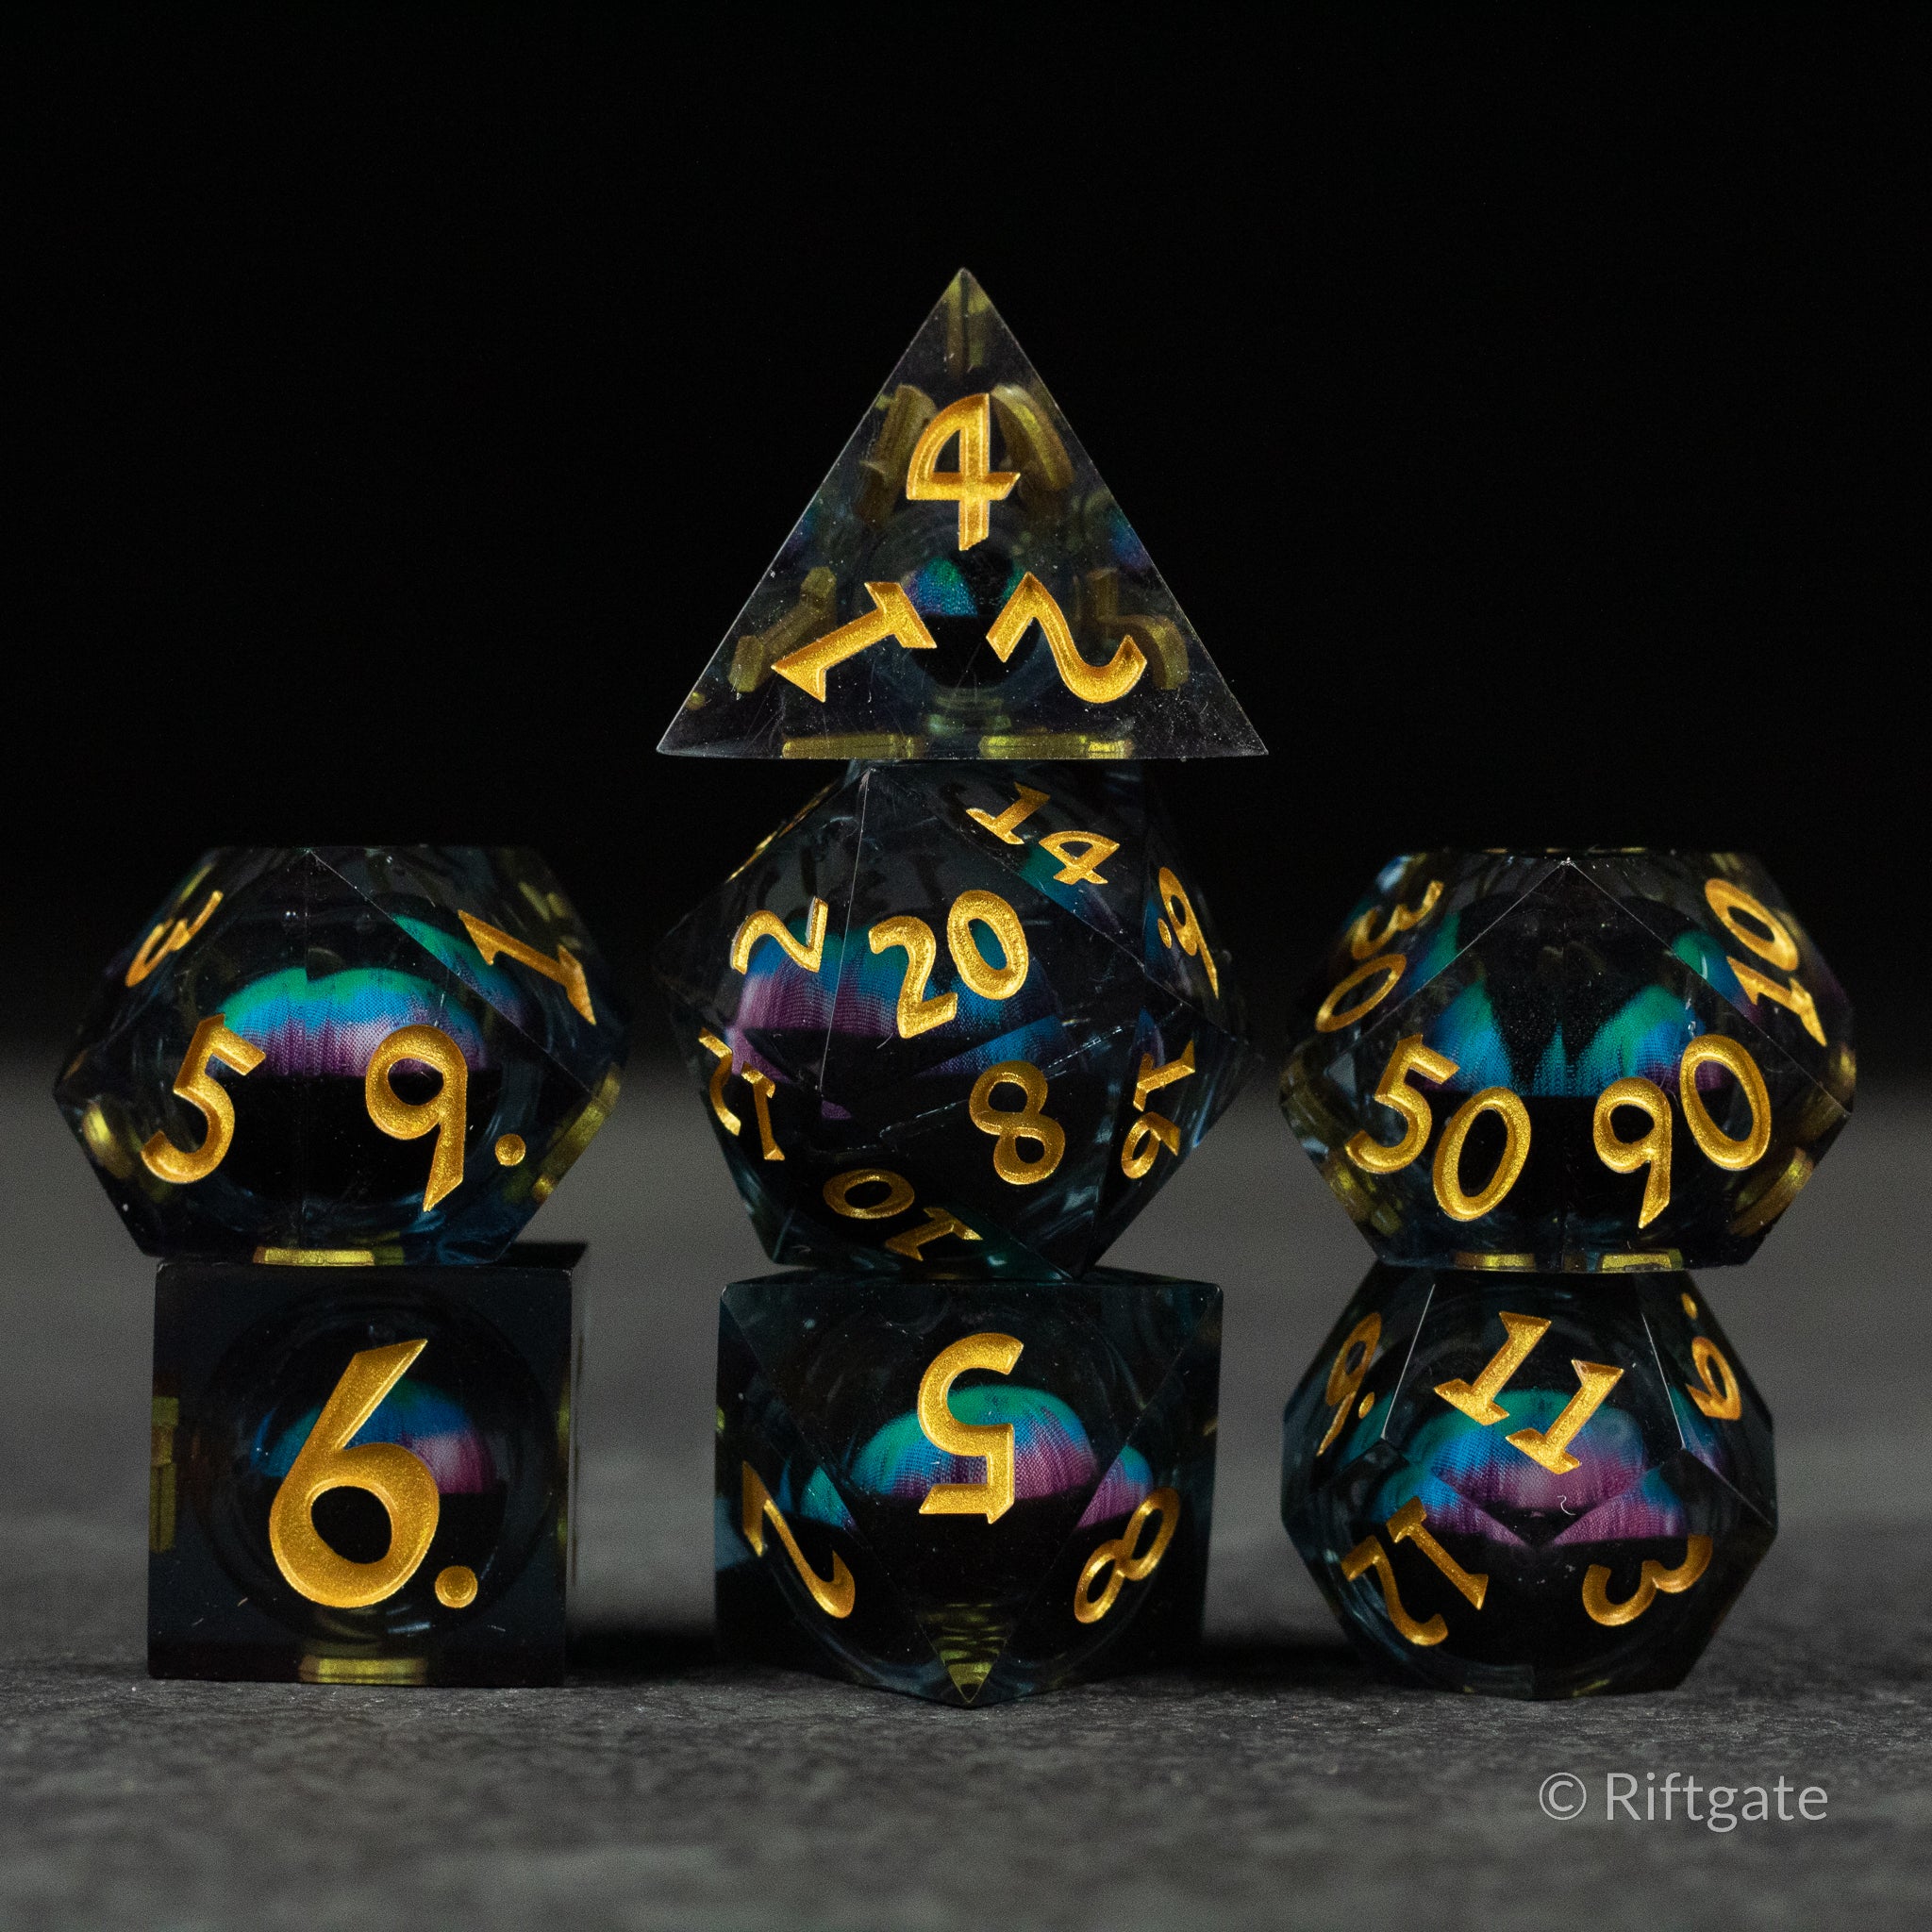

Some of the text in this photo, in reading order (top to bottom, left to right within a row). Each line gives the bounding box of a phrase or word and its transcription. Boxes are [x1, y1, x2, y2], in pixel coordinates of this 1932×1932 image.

[907, 391, 1021, 551] 4
[772, 581, 938, 703] 1
[986, 571, 1148, 704] 2
[965, 781, 1121, 886] 14
[728, 896, 829, 975] 2
[869, 890, 1029, 1040] 20
[1704, 877, 1828, 1048] 10
[141, 1013, 267, 1183] 5
[969, 1060, 1066, 1186] 8
[1344, 1034, 1532, 1222] 50
[1592, 1034, 1772, 1228] 90
[918, 1333, 1024, 1524] 5
[1433, 1311, 1625, 1475] 11
[742, 1459, 856, 1620] 2
[1074, 1487, 1180, 1624] 8
[1341, 1496, 1490, 1647] 12
[1582, 1533, 1713, 1627] 3
